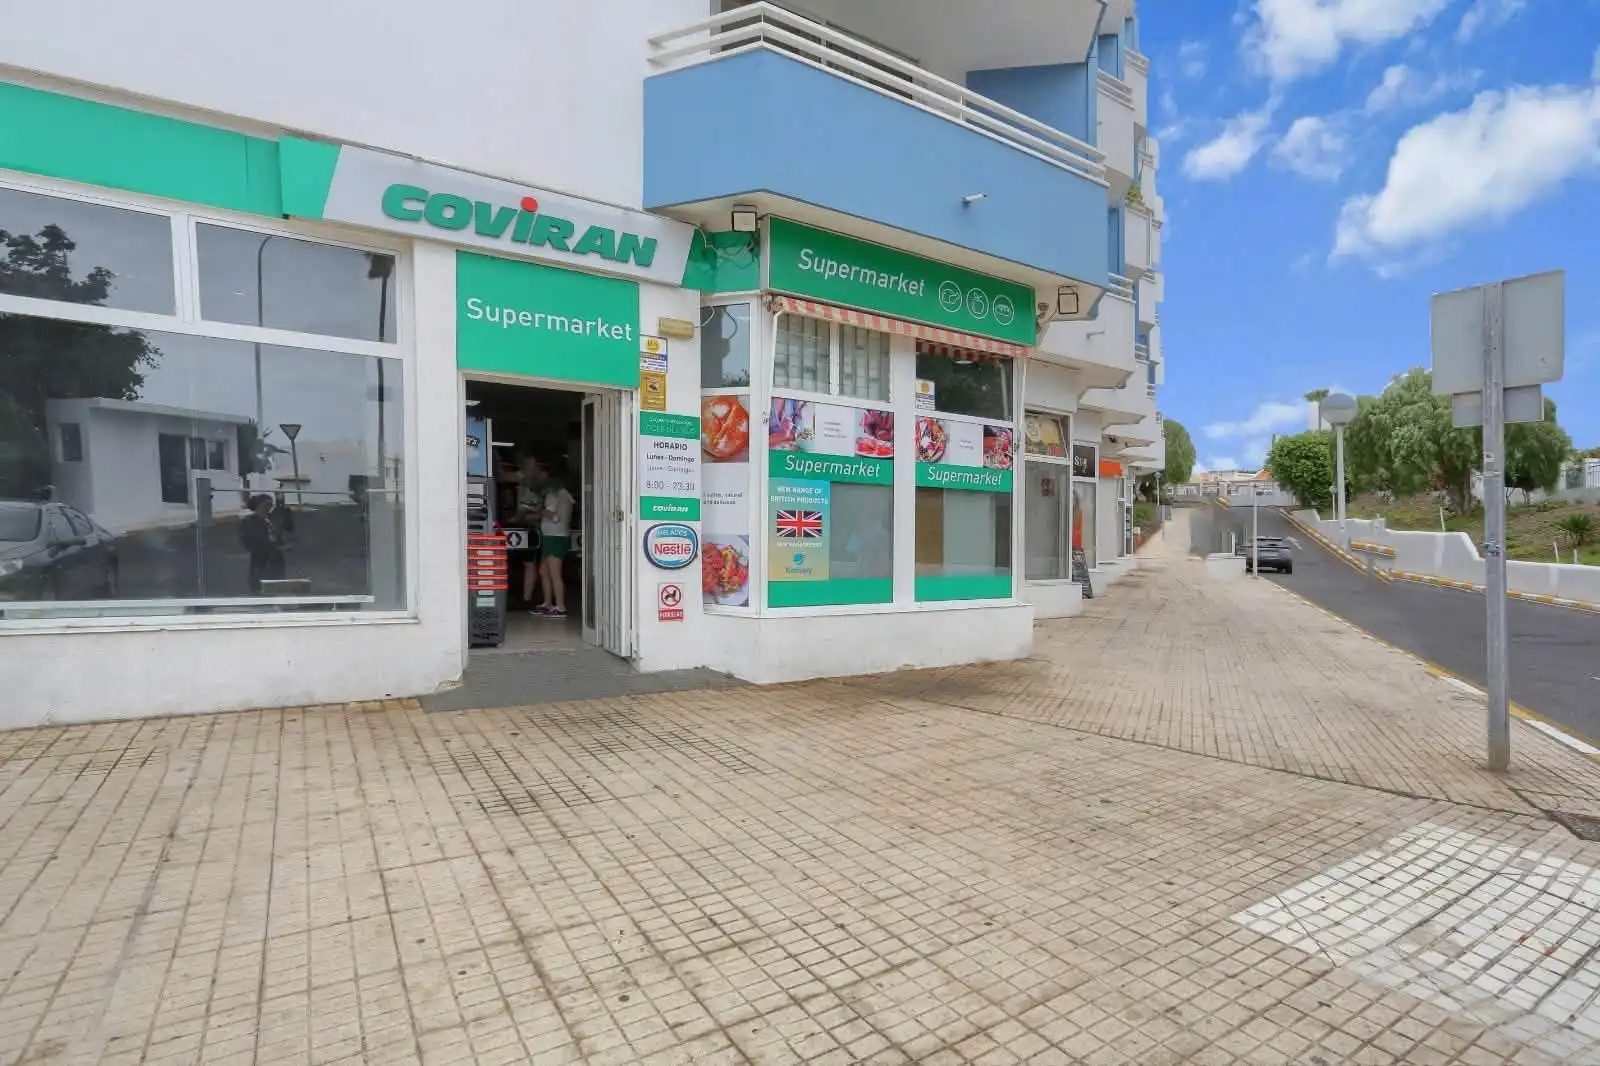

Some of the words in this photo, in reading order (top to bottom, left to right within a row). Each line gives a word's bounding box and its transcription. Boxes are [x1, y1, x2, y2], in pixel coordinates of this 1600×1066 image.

[798, 248, 925, 297] Supermarket
[466, 297, 633, 342] Supermarket
[653, 441, 688, 451] HORARIO
[785, 455, 881, 477] Supermarket
[928, 467, 1002, 485] Supermarket
